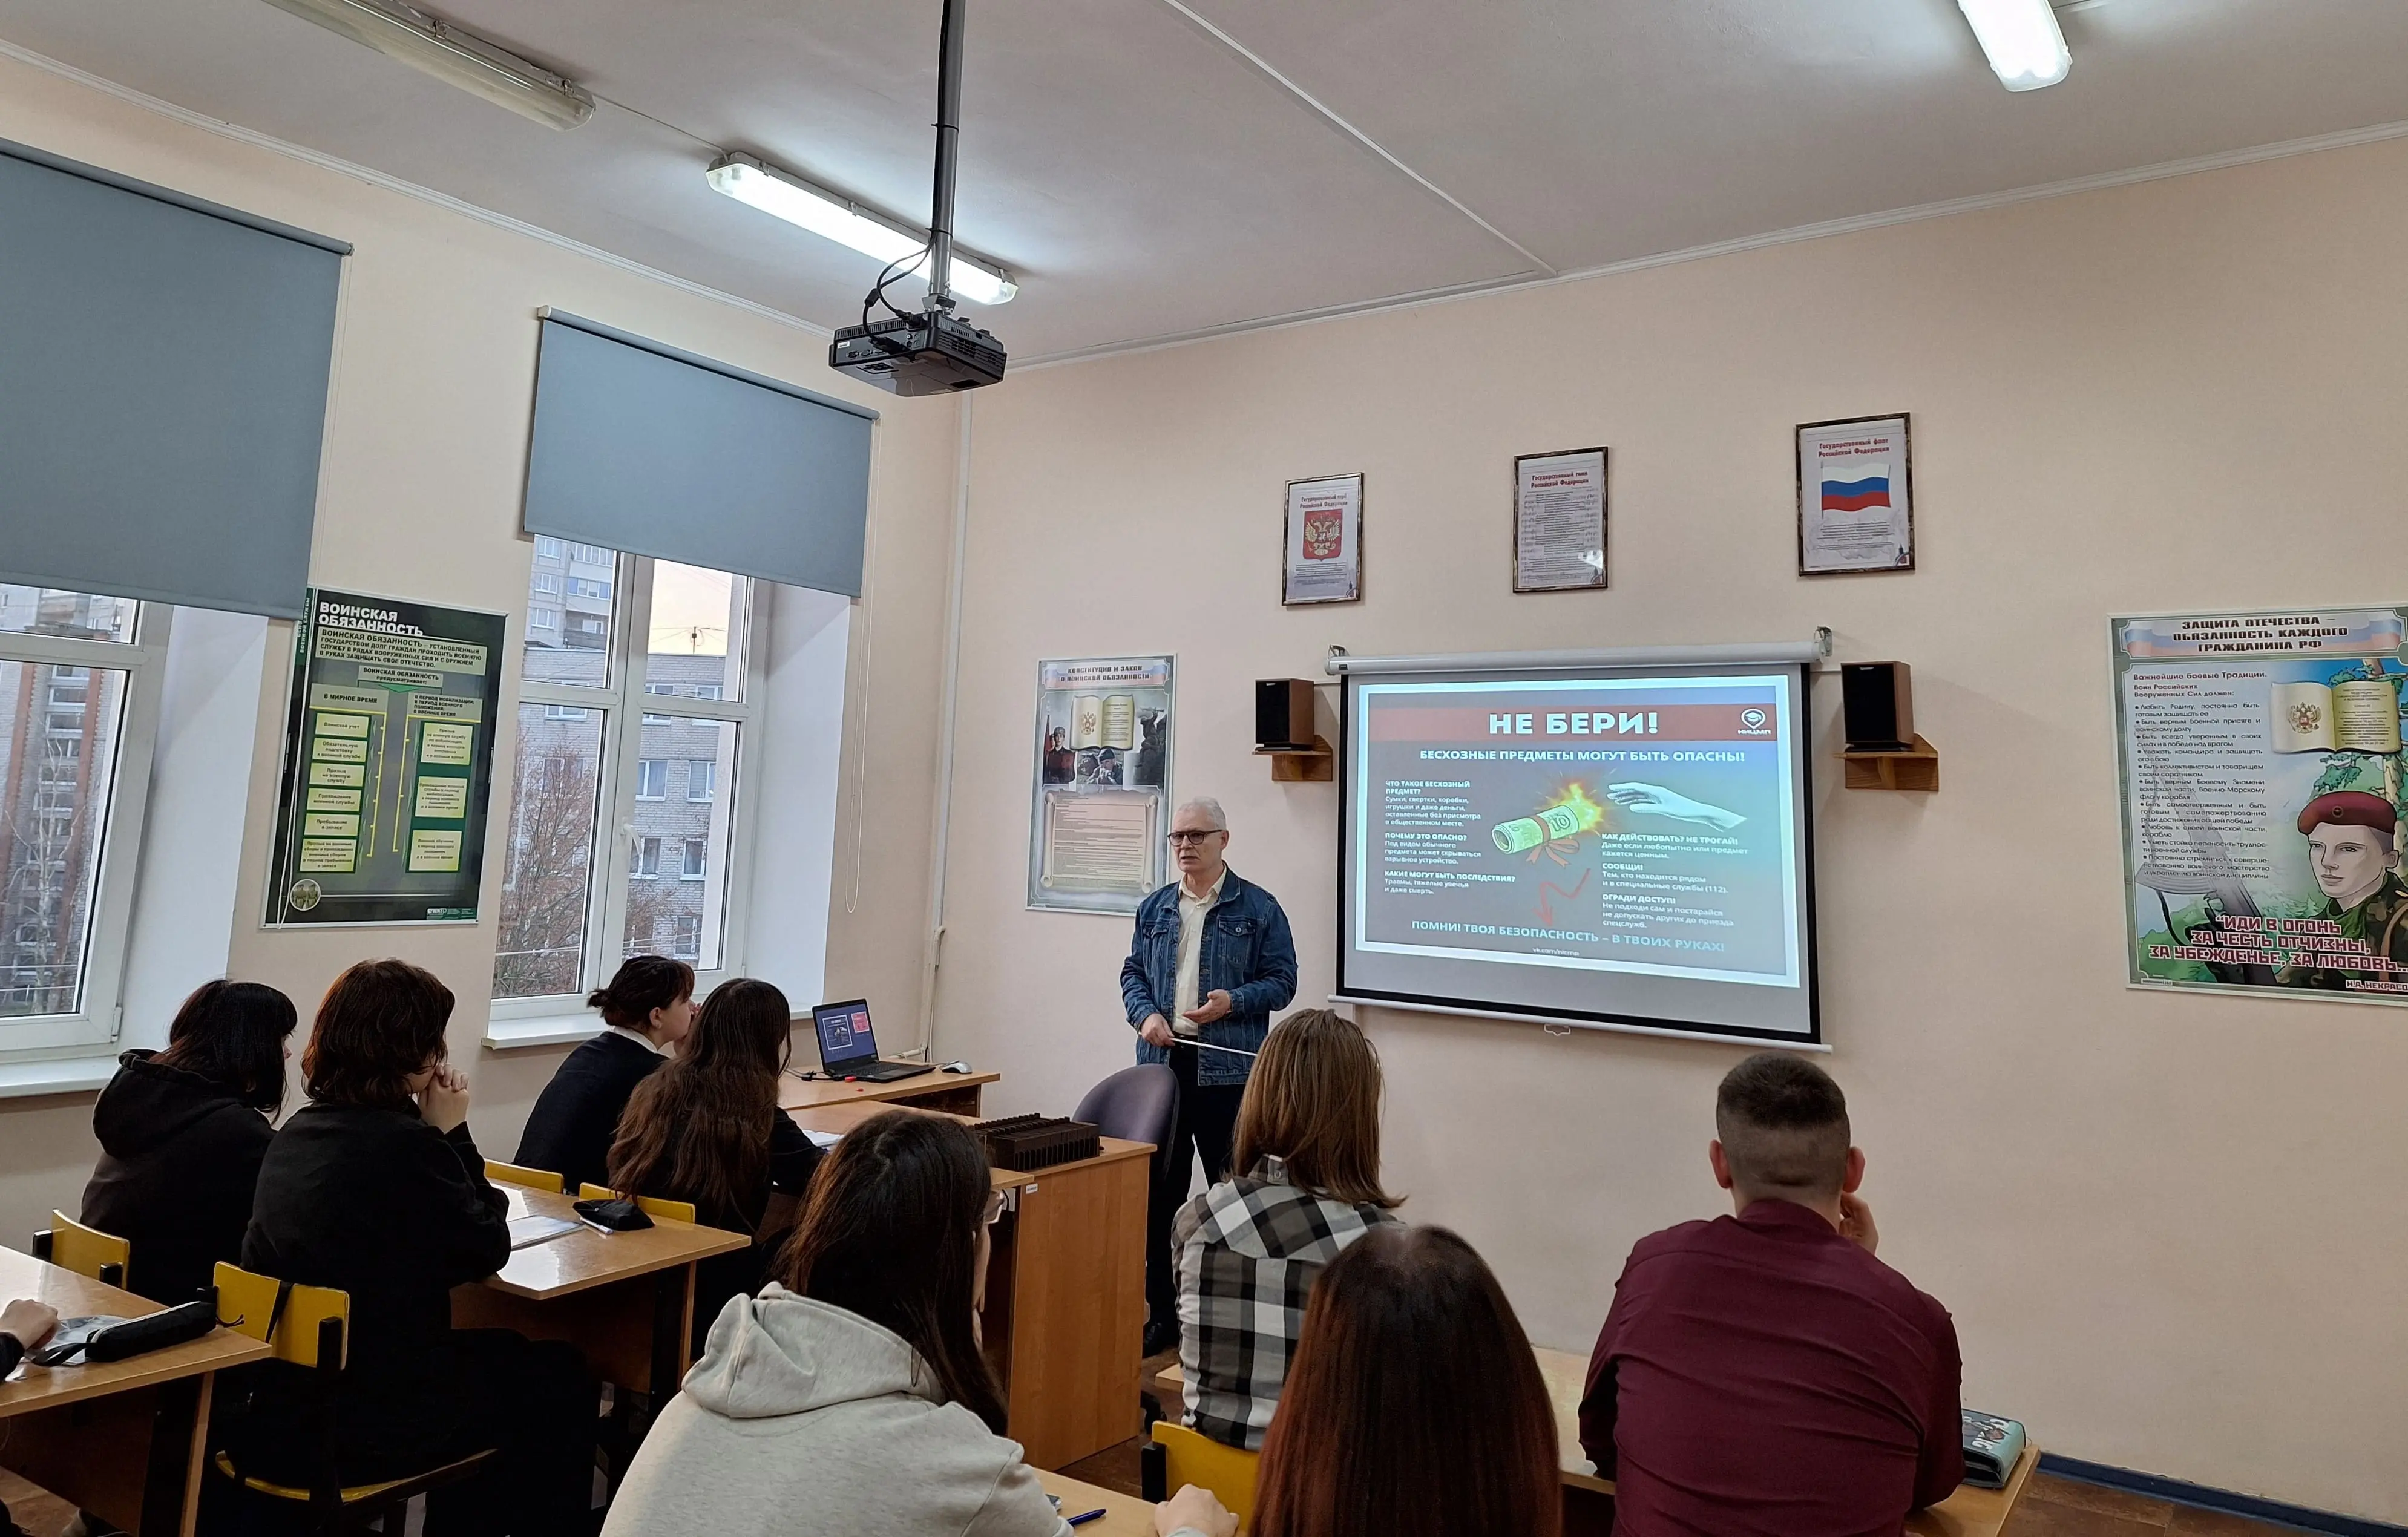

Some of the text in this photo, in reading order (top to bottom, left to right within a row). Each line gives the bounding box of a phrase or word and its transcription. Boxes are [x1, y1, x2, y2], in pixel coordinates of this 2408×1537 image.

[320, 602, 398, 622] ВОИНСКАЯ
[318, 614, 424, 636] ОБЯЗАННОСТЬ
[2182, 617, 2320, 629] ЗАЩИТА ОТЕЧЕСТВА
[2173, 627, 2348, 641] ОБЯЗАННОСТЬ КАЖДОГО
[322, 629, 479, 654] ВОИНСКАЯ ОБЯЗАННОСТЬ УСТАНОВЛЕННЫЙ
[2198, 641, 2293, 652] ГРАЖДАНИНА
[320, 644, 345, 652] СЛУЖБУ
[353, 647, 373, 655] РЯДАХ
[375, 650, 420, 660] ВООРУЖЕННЫХ
[321, 637, 369, 648] ГОСУДАРСТВОМ
[418, 647, 452, 657] ПРОХОДИТЬ
[454, 652, 482, 661] ВОЕННУЮ
[346, 653, 381, 662] ЗАЩИЩАТЬ
[364, 667, 439, 680] ВОИНСКАЯ ОБЯЗАННОСТЬ
[1489, 712, 1658, 735] НЕ БЕРИ!
[1420, 750, 1745, 762] БЕСХОЗНЫЕ ПРЕДМЕТЫ МОГУТ БЫТЬ ОПАСНЫ!
[1619, 833, 1684, 842] ДЕЙСТВОВАТЬ?
[1699, 836, 1738, 845] ТРОГАЙ!
[1457, 873, 1515, 882] ПОСЛЕДСТВИЯ?
[1638, 896, 1675, 904] ДОСТУП!
[1603, 920, 1647, 928] спецслужб.
[1698, 918, 1734, 926] приезда
[2266, 918, 2278, 931] В
[2283, 919, 2341, 935] ОГОНЬ
[1412, 920, 1724, 952] ПОМНИ! ТВОЯ БЕЗОПАСНОСТЬ В ТВОИХ РУКАХ!
[2191, 930, 2371, 955] ЗА ЧЕСТЬ ОТЧИЗНЫ,
[2149, 944, 2170, 959] ЗА
[2174, 946, 2286, 966] УБЕЖДЕНЬЕ,
[2290, 952, 2314, 967] ЗА
[2366, 981, 2408, 991] НЕКРАСО
